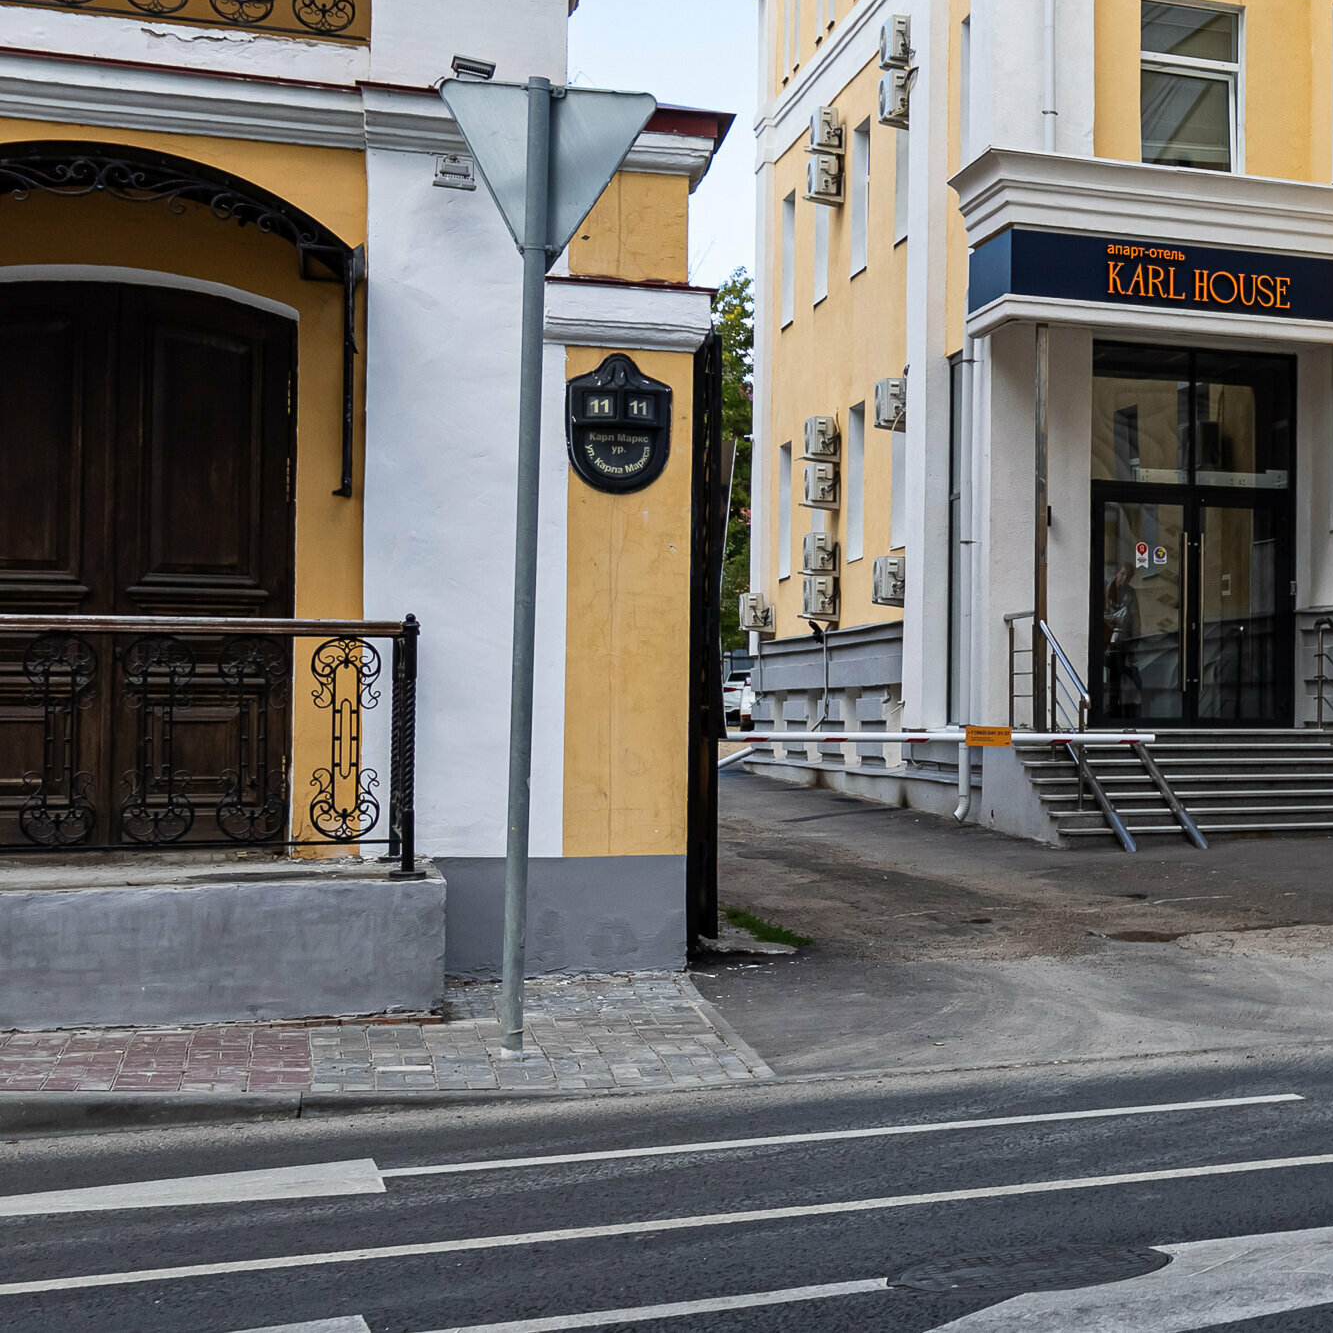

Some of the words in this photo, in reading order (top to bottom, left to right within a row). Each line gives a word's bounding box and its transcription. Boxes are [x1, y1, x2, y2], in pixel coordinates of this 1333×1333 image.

[1107, 244, 1186, 261] апарт-отель
[1107, 261, 1186, 299] KARL
[1193, 269, 1291, 309] HOUSE
[590, 399, 609, 413] 11
[630, 400, 647, 416] 11
[589, 433, 614, 442] Карл
[617, 434, 649, 444] Маркс
[611, 446, 627, 454] ур.
[585, 444, 595, 459] ул.
[594, 457, 623, 473] Карла
[625, 446, 650, 473] Маркса
